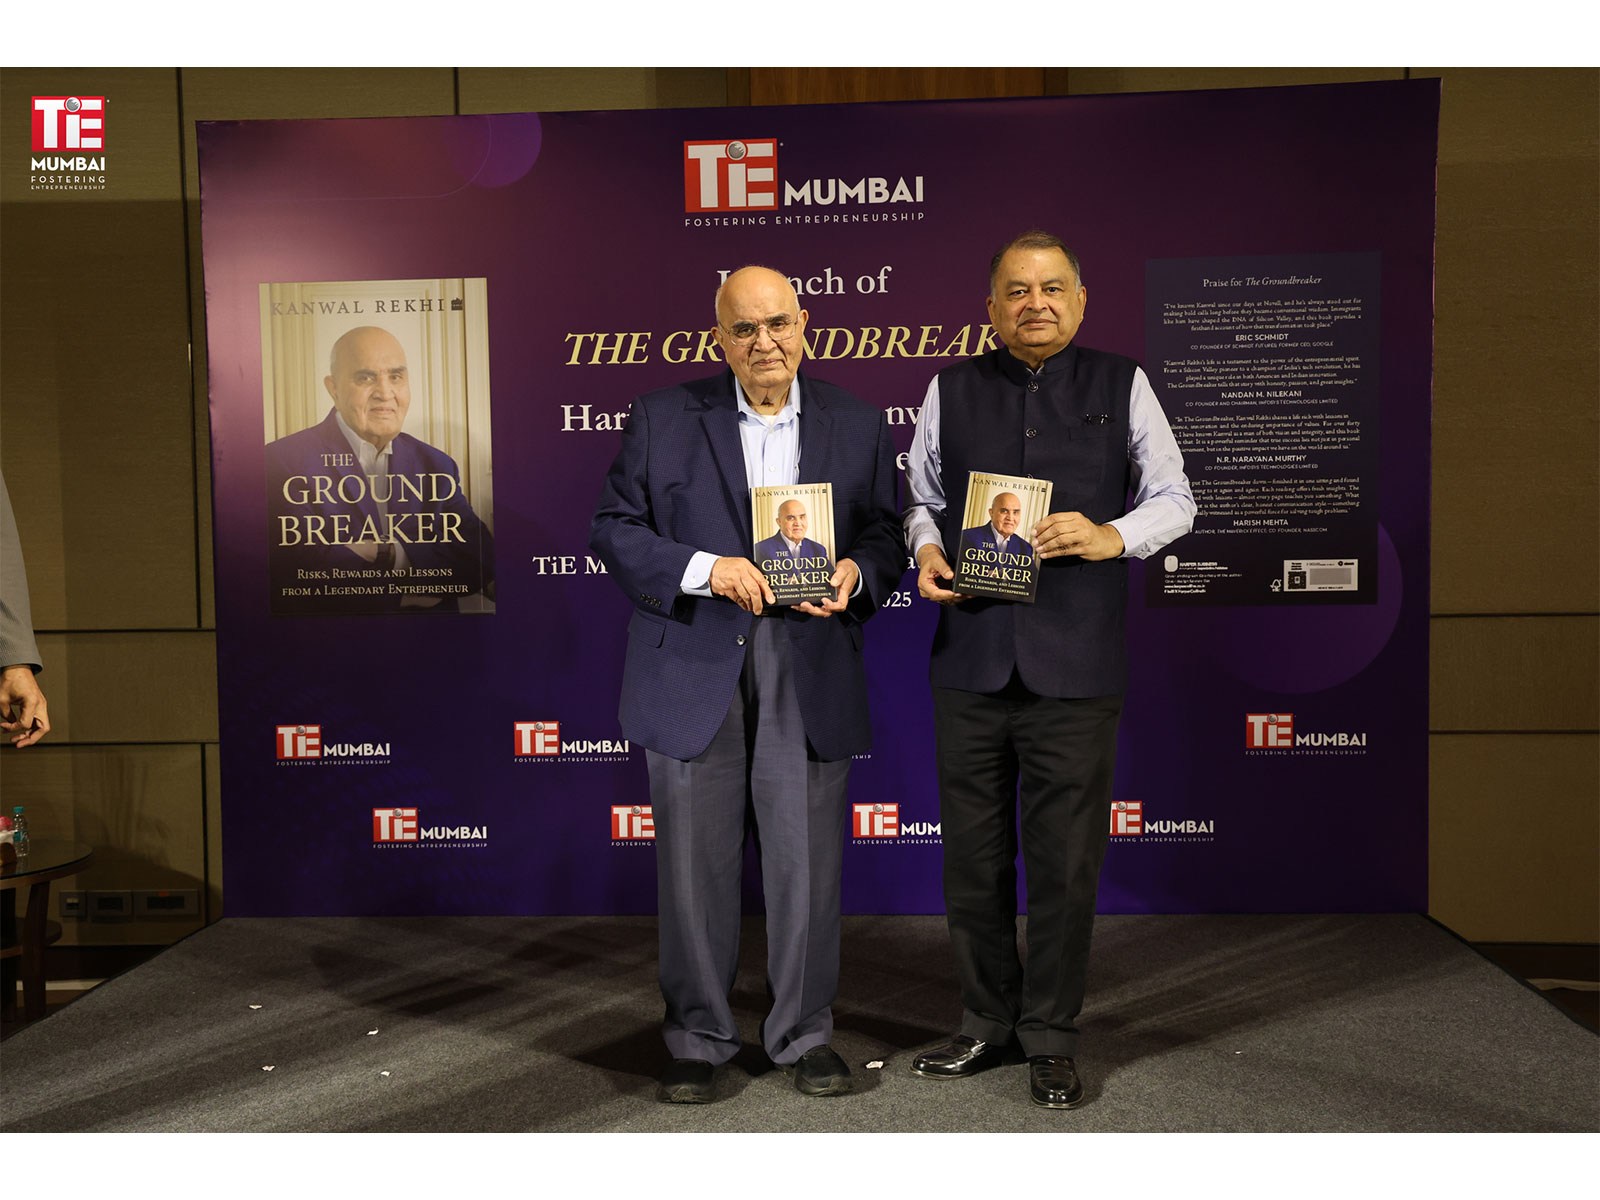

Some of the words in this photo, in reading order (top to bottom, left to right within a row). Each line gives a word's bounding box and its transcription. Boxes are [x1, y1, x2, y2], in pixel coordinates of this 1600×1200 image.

[784, 175, 925, 207] MUMBAI
[684, 217, 767, 228] FOSTERING
[776, 212, 925, 226] ENTREPRENEURSHIP
[856, 266, 893, 294] of
[1203, 278, 1229, 288] Praise
[1230, 278, 1243, 287] for
[1245, 276, 1261, 286] The
[1262, 274, 1322, 286] Groundbreaker
[272, 300, 364, 316] KANWAL
[375, 298, 445, 313] REKHI
[564, 332, 652, 365] THE
[320, 453, 354, 467] THE
[282, 472, 458, 505] GROUND
[974, 478, 1009, 488] KANWAL
[1012, 482, 1040, 492] REKHI
[278, 512, 467, 546] BREAKER
[761, 556, 828, 572] GROUND
[965, 548, 1032, 567] GROUND
[332, 568, 382, 580] REWARDS
[408, 566, 452, 578] LESSONS
[532, 556, 577, 575] TiE
[960, 562, 1032, 584] BREAKER
[324, 584, 385, 596] LEGENDARY
[388, 583, 468, 594] ENTREPRENEUR
[562, 740, 629, 754] MUMBAI
[1296, 732, 1366, 747] MUMBAI
[323, 743, 390, 757] MUMBAI
[420, 826, 487, 840] MUMBAI
[901, 822, 942, 835] MUM
[1145, 820, 1214, 833] MUMBAI
